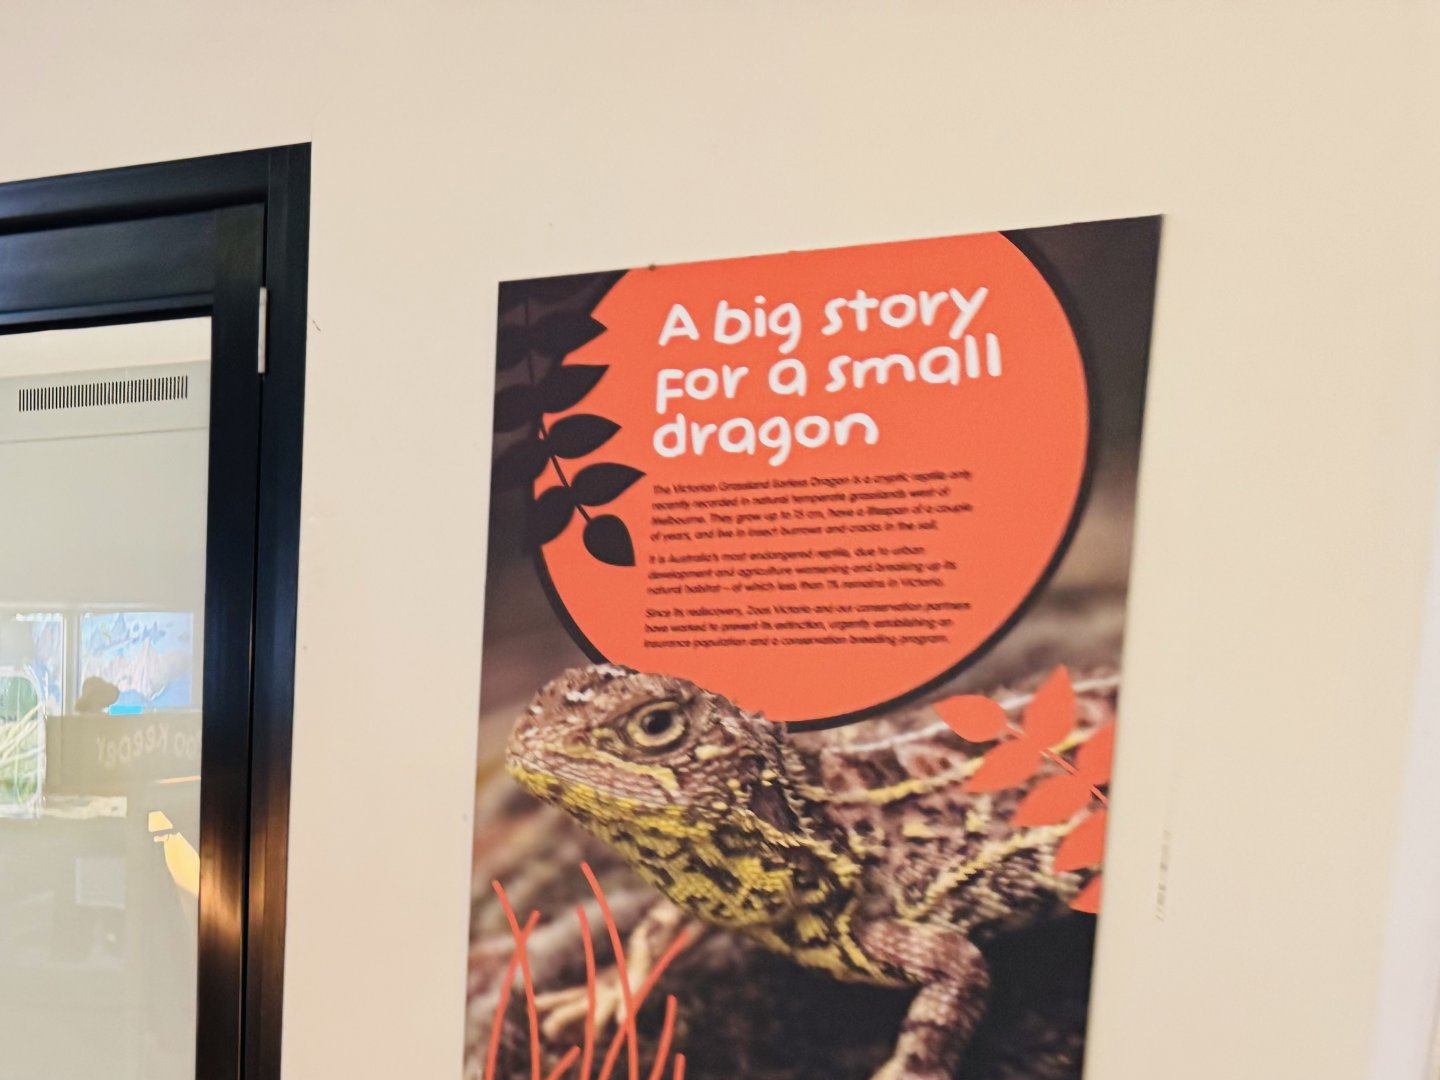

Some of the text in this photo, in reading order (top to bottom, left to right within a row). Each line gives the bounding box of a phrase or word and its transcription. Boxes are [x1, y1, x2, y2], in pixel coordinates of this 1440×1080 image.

[658, 287, 989, 354] A big story
[768, 358, 807, 397] a
[824, 332, 1002, 393] small
[652, 413, 879, 467] dragon
[811, 477, 848, 487] Dragon
